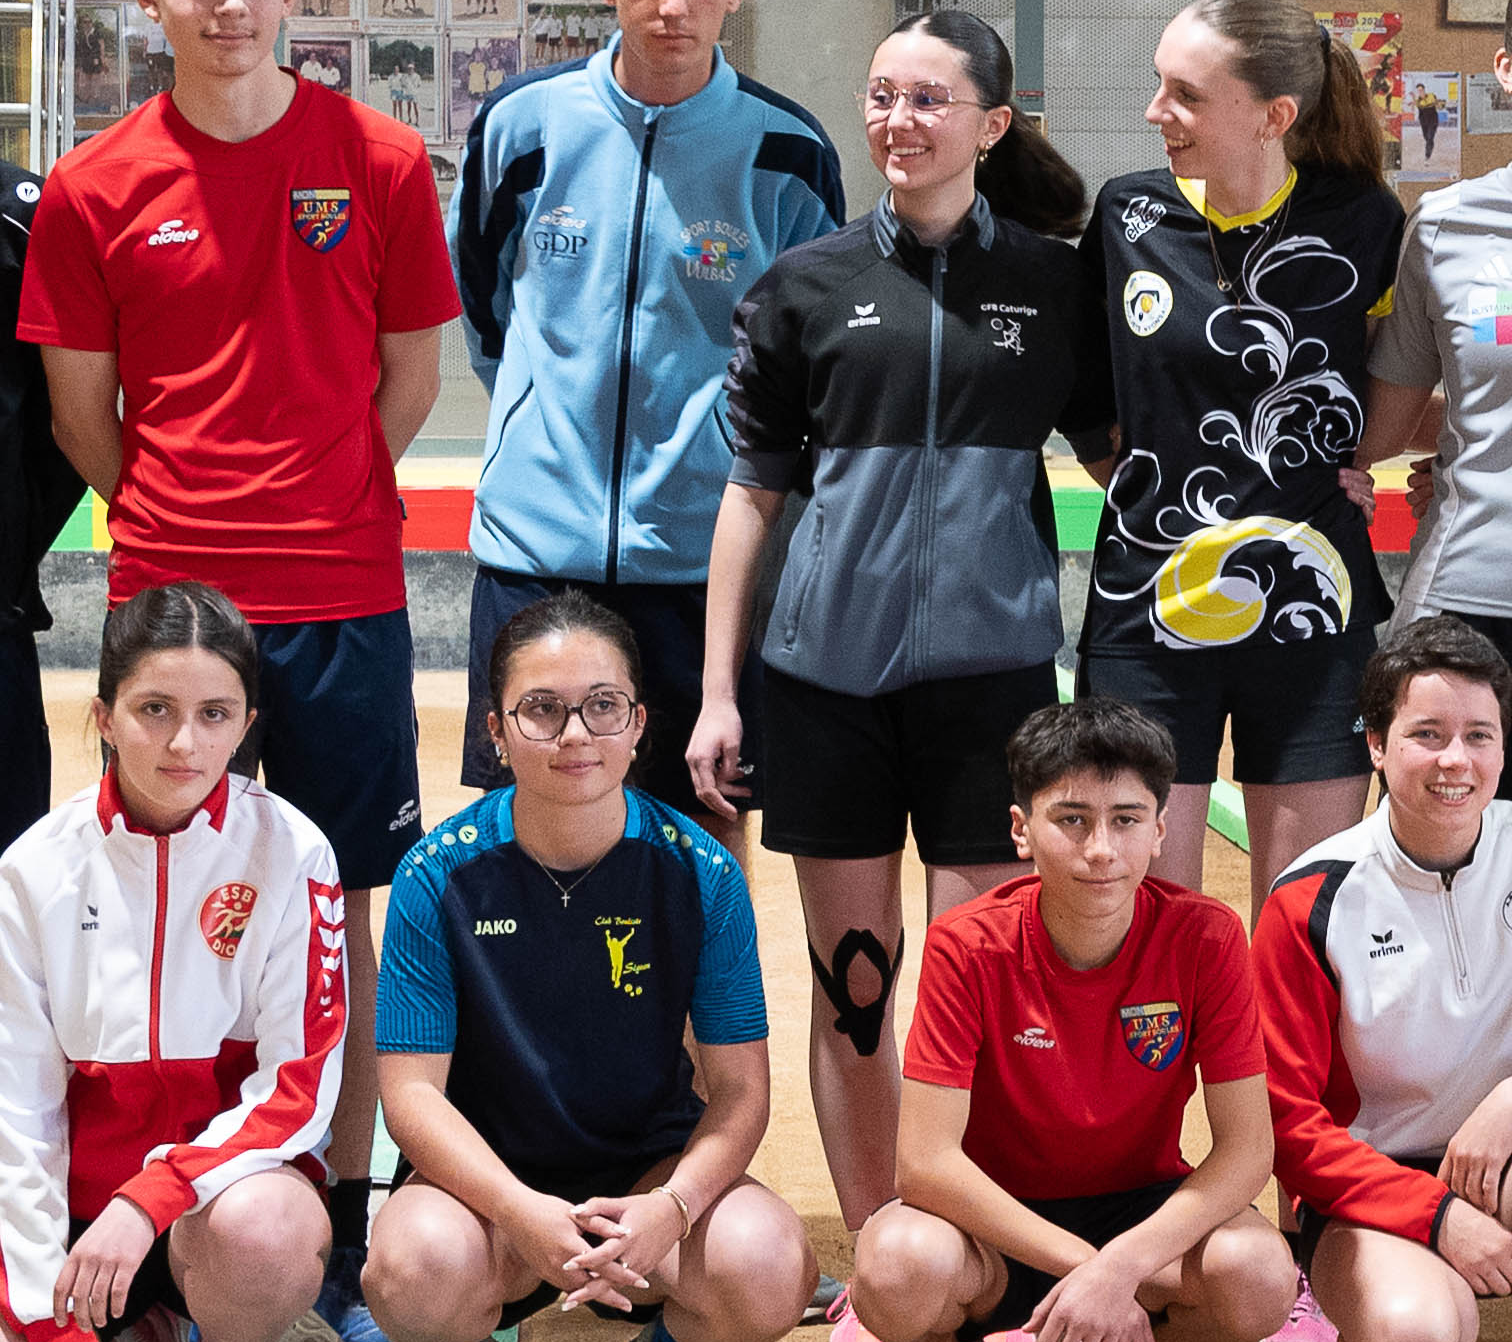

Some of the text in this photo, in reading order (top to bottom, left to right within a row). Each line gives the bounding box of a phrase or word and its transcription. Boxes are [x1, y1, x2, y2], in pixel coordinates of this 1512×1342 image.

[534, 231, 587, 257] GDP
[999, 303, 1039, 317] Caturige
[220, 886, 252, 902] ESB
[474, 919, 517, 937] JAKO
[1369, 944, 1404, 959] erima
